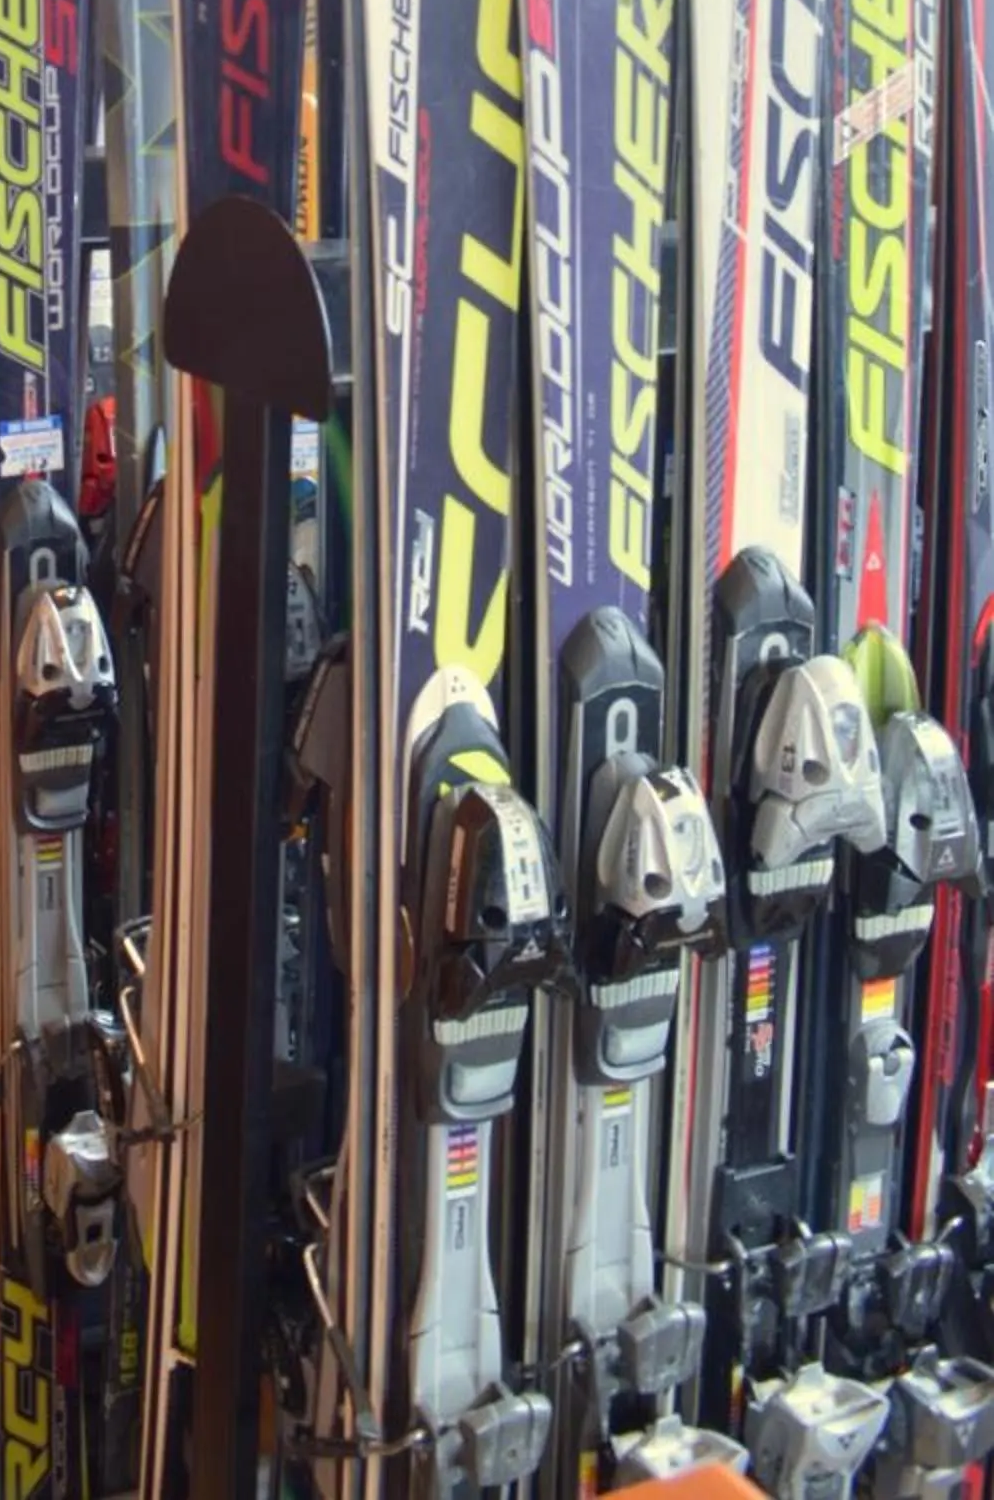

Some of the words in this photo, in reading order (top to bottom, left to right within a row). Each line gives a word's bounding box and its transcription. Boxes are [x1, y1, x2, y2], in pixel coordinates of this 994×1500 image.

[45, 67, 63, 330] WORLDCUP
[386, 218, 408, 335] SC
[529, 47, 574, 587] WORLDCUP
